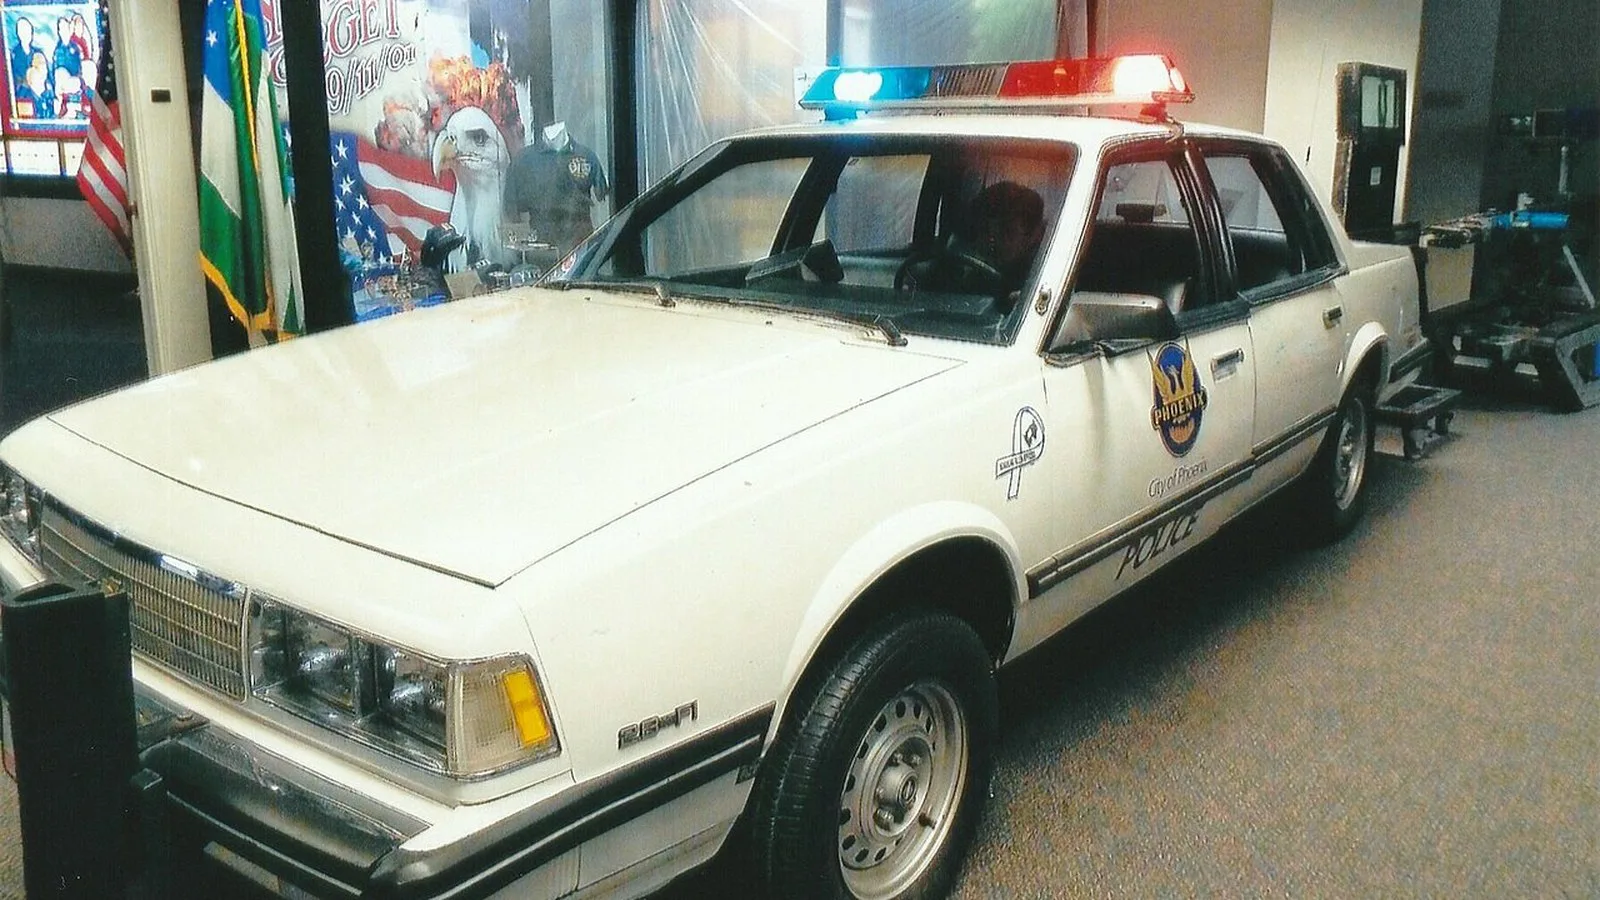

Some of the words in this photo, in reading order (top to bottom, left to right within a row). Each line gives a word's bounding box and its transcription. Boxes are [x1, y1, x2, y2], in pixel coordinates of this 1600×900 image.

[325, 43, 416, 114] 9/11/01
[1153, 389, 1205, 425] PHOENIX
[1148, 478, 1166, 498] City
[1115, 513, 1199, 580] POLICE
